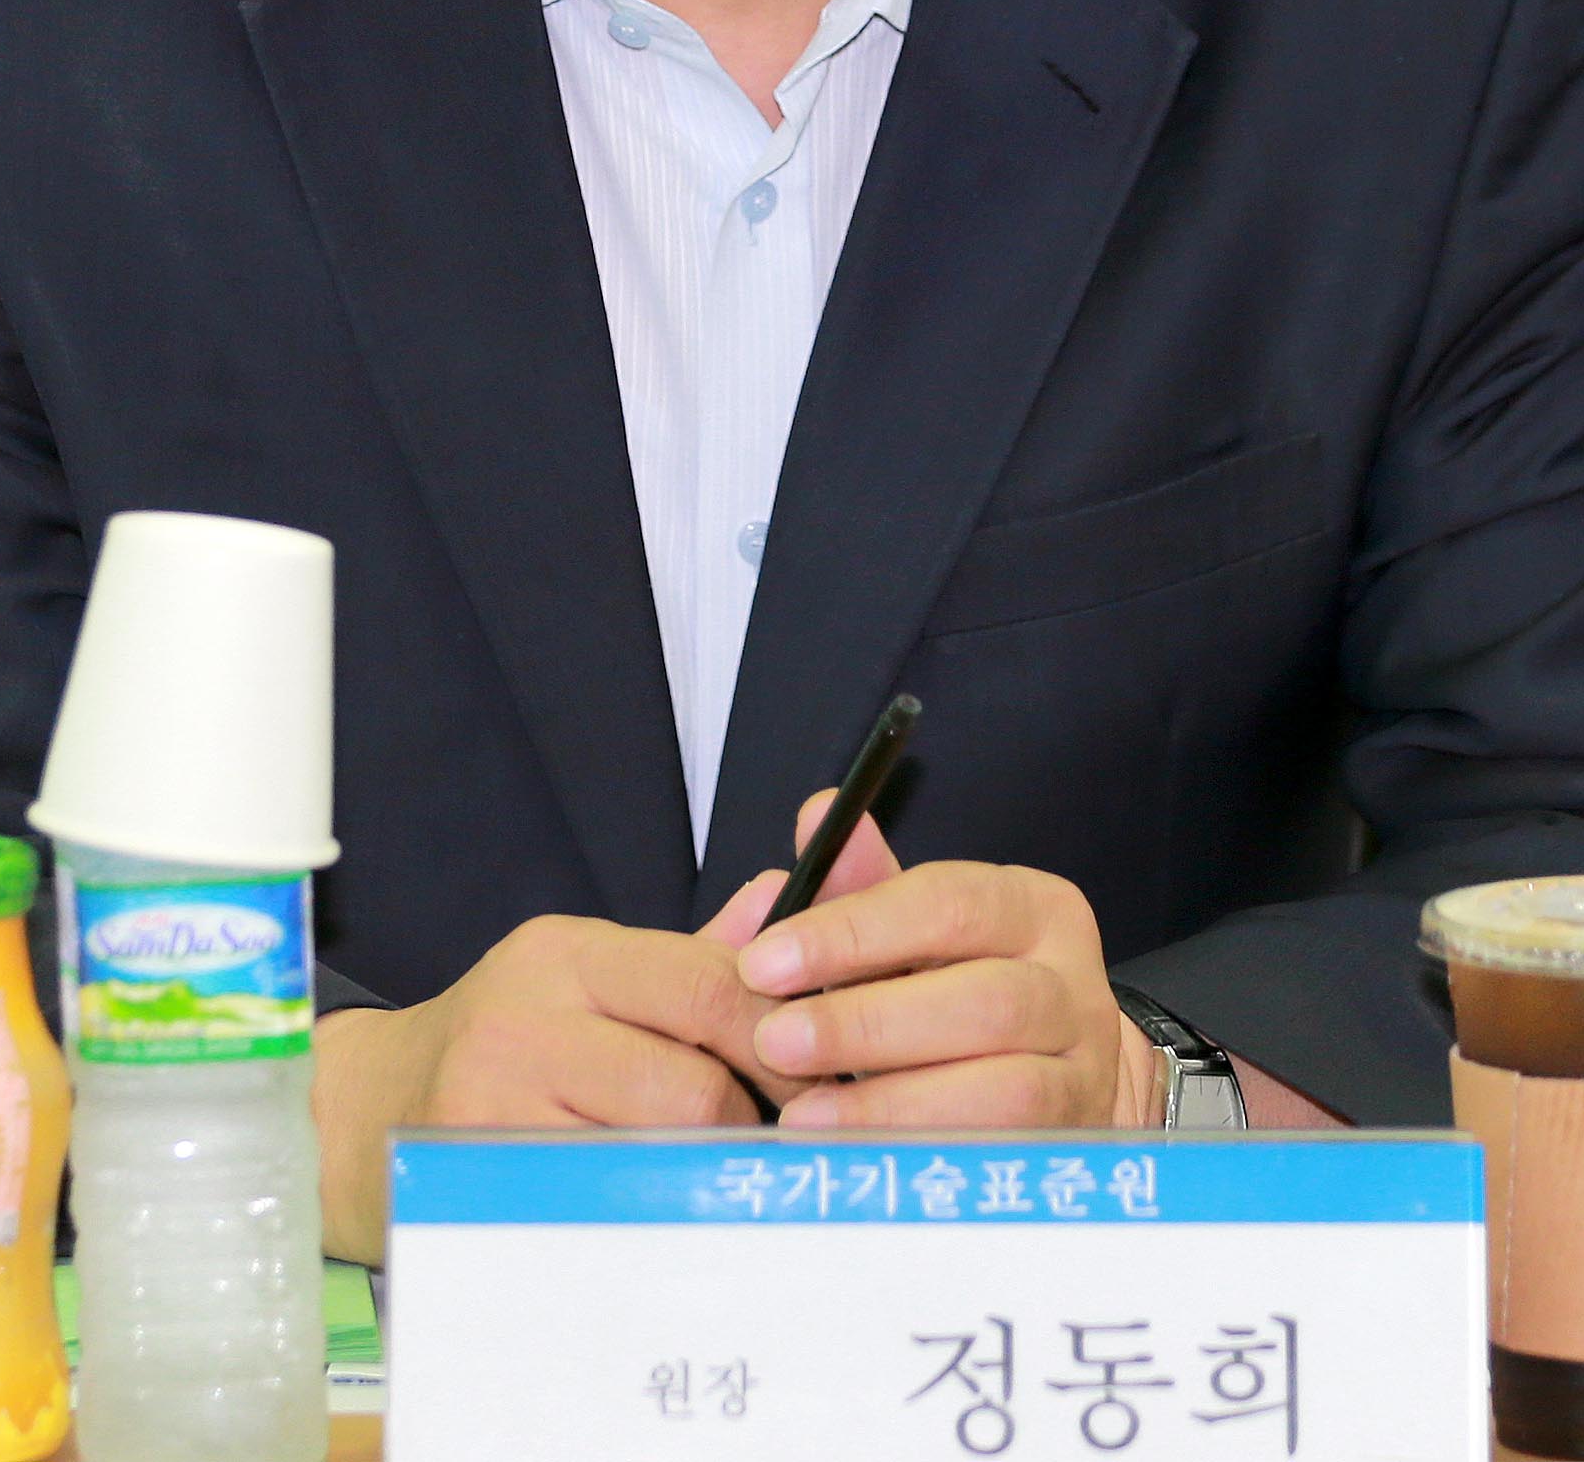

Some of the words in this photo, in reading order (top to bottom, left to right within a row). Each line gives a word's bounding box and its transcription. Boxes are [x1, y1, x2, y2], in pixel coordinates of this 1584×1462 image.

[716, 1154, 1161, 1219] 국가기술표준원
[643, 1358, 758, 1418] 원장
[901, 1314, 1301, 1457] 정동희
